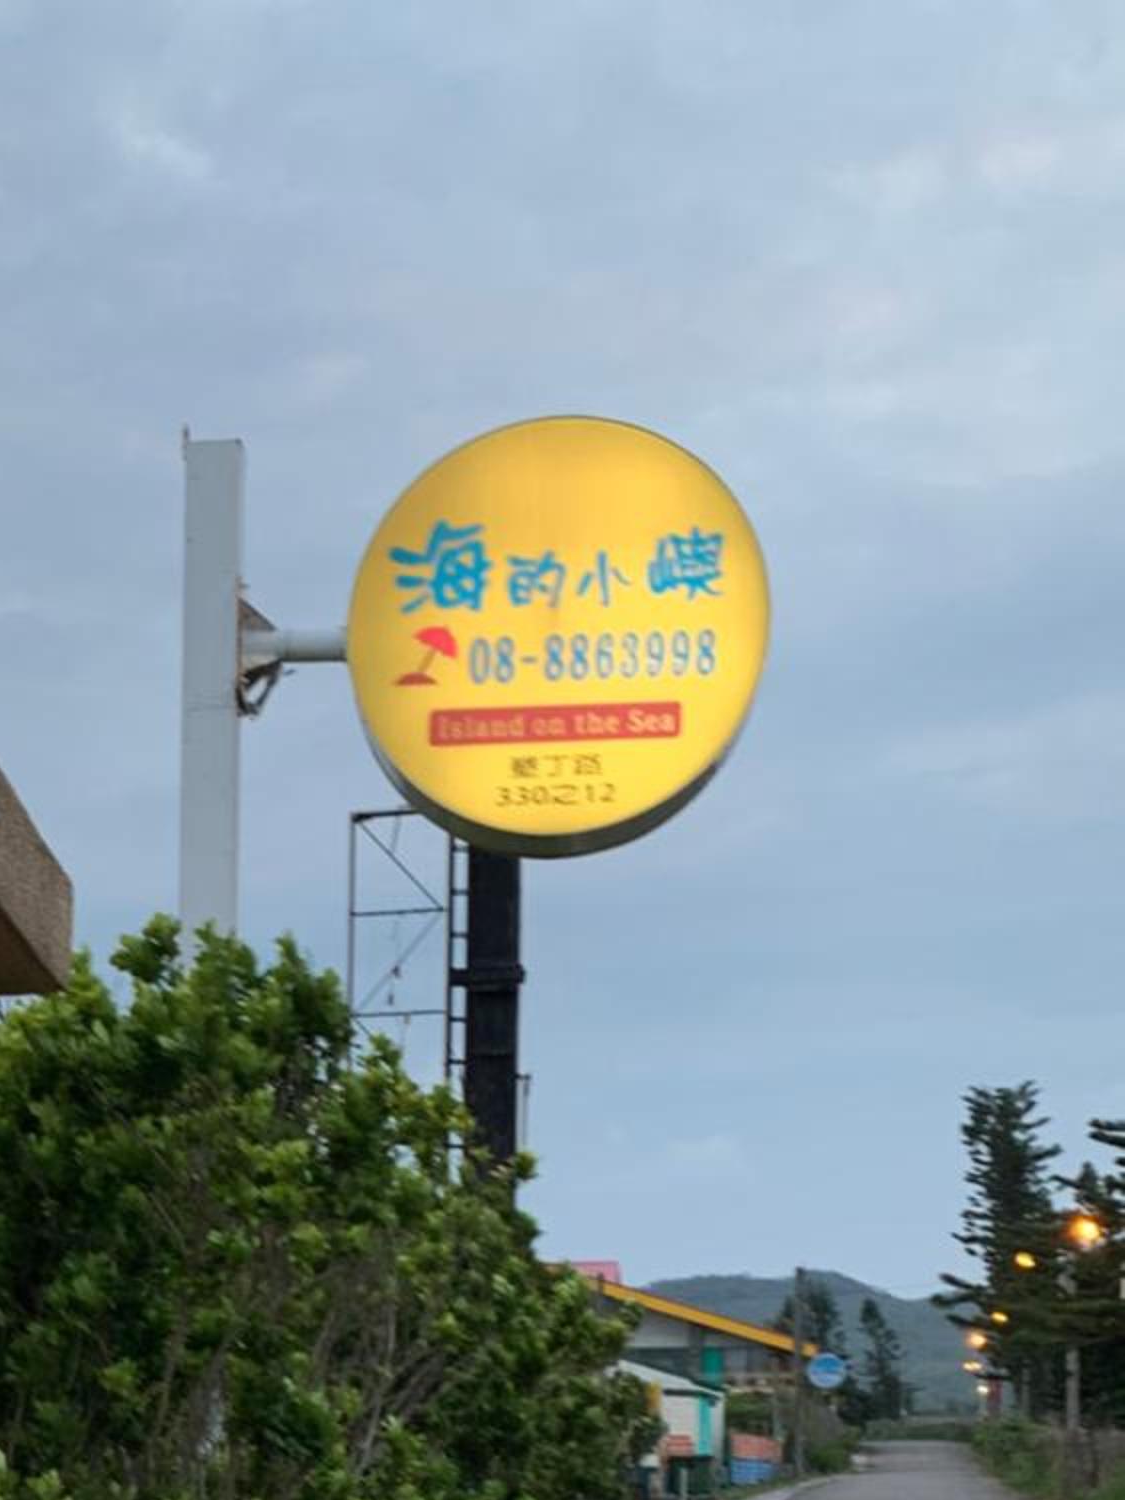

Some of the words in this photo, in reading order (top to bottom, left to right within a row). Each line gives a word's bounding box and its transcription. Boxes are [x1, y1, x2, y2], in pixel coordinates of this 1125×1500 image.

[388, 520, 724, 614] 海的小嶼
[468, 629, 716, 685] 08-8863998
[437, 714, 525, 740] Island
[531, 717, 566, 737] on
[572, 711, 620, 735] the
[626, 707, 676, 734] Sea
